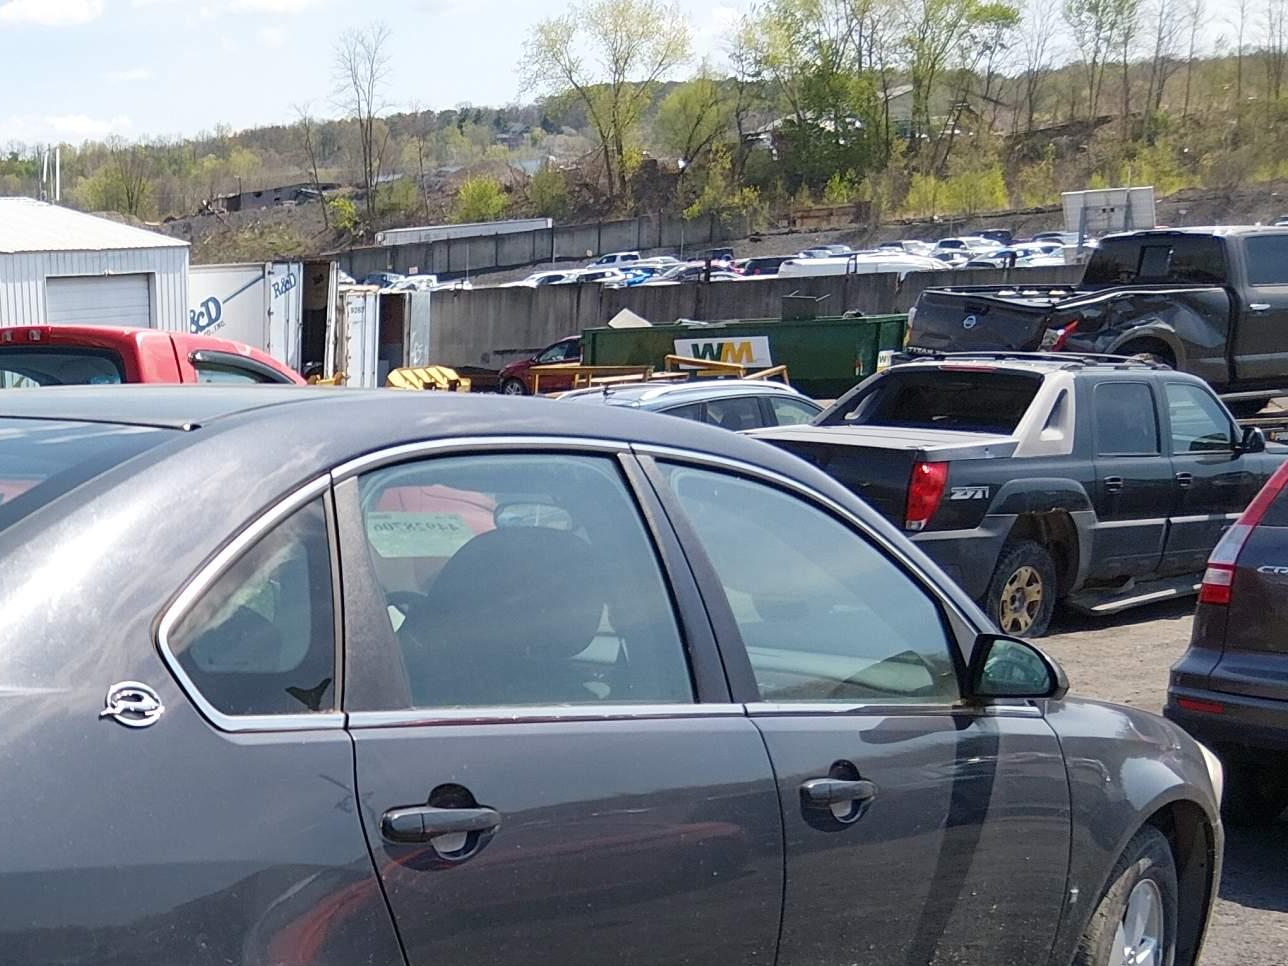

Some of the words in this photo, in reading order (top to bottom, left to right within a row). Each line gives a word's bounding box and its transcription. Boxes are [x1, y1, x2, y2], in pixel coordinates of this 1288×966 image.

[272, 272, 297, 299] R&D
[691, 341, 754, 364] WM
[951, 486, 989, 499] Z71
